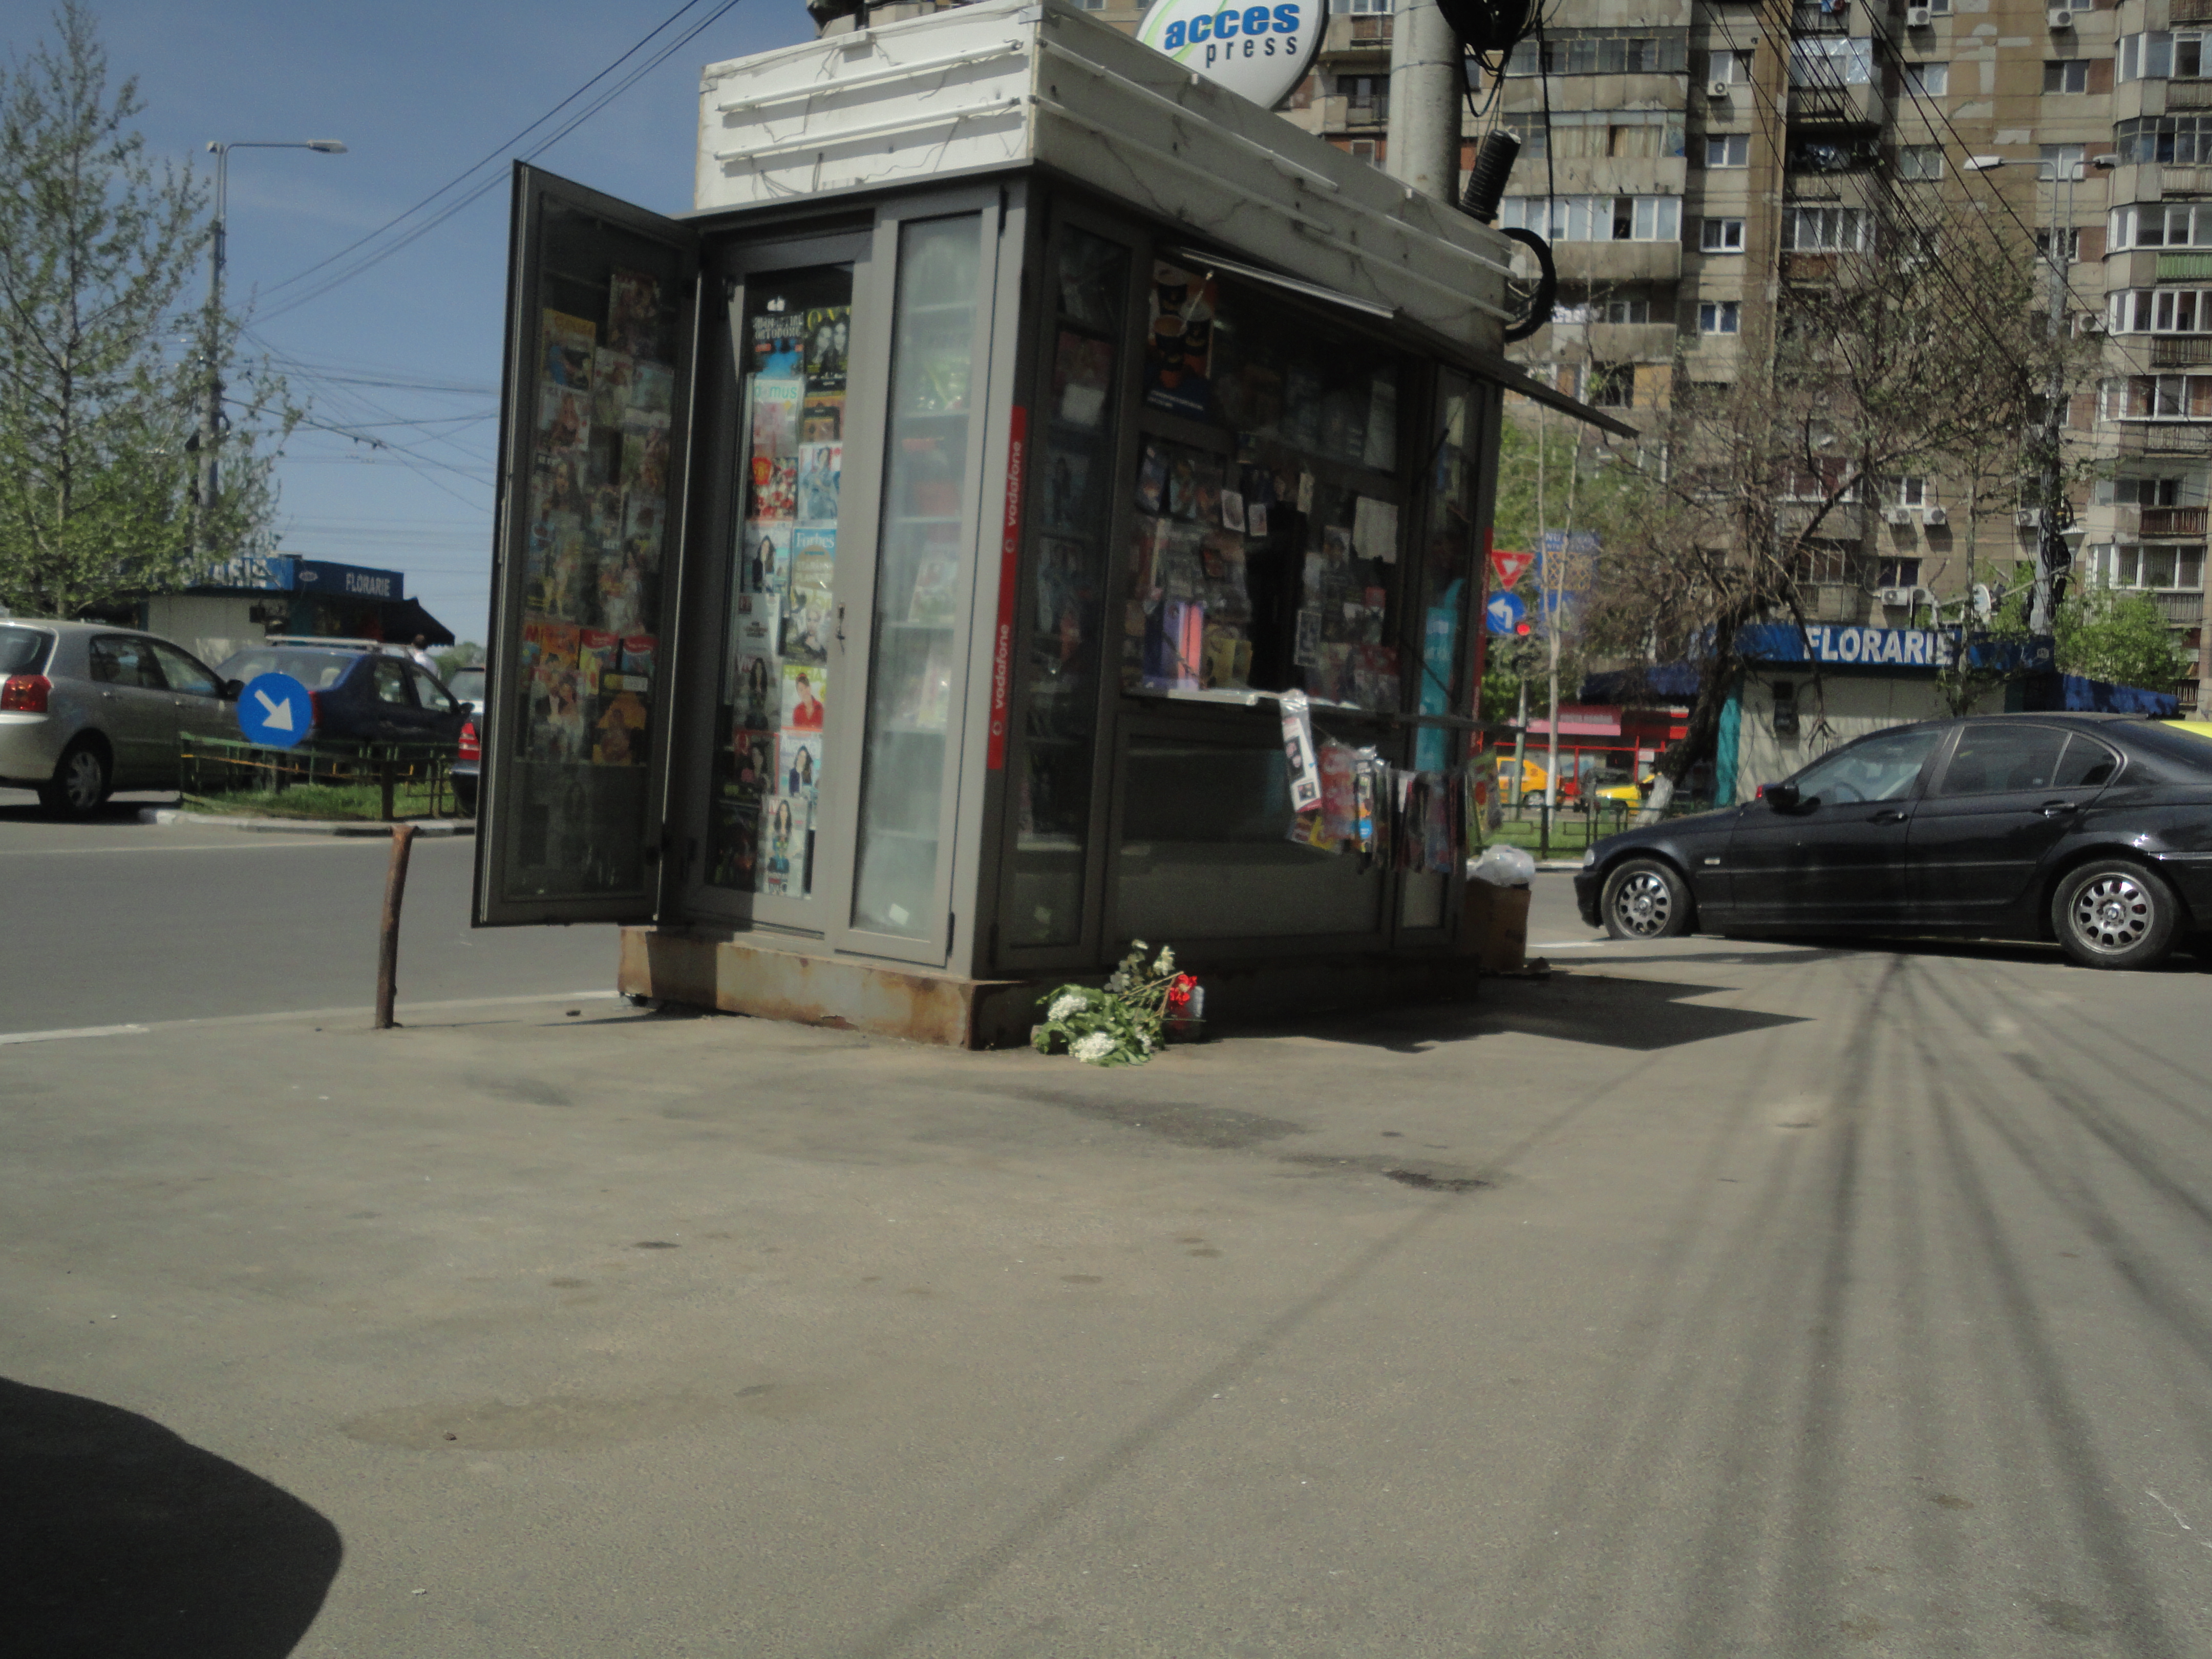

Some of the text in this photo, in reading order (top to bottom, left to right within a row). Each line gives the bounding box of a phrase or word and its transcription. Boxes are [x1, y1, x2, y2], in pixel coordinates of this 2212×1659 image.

[1164, 3, 1300, 50] acces
[1206, 35, 1298, 68] press
[1007, 440, 1023, 527] vodafone
[346, 571, 391, 597] FLORARIE
[995, 624, 1010, 710] vodafone
[1803, 626, 1955, 665] FLORARIE
